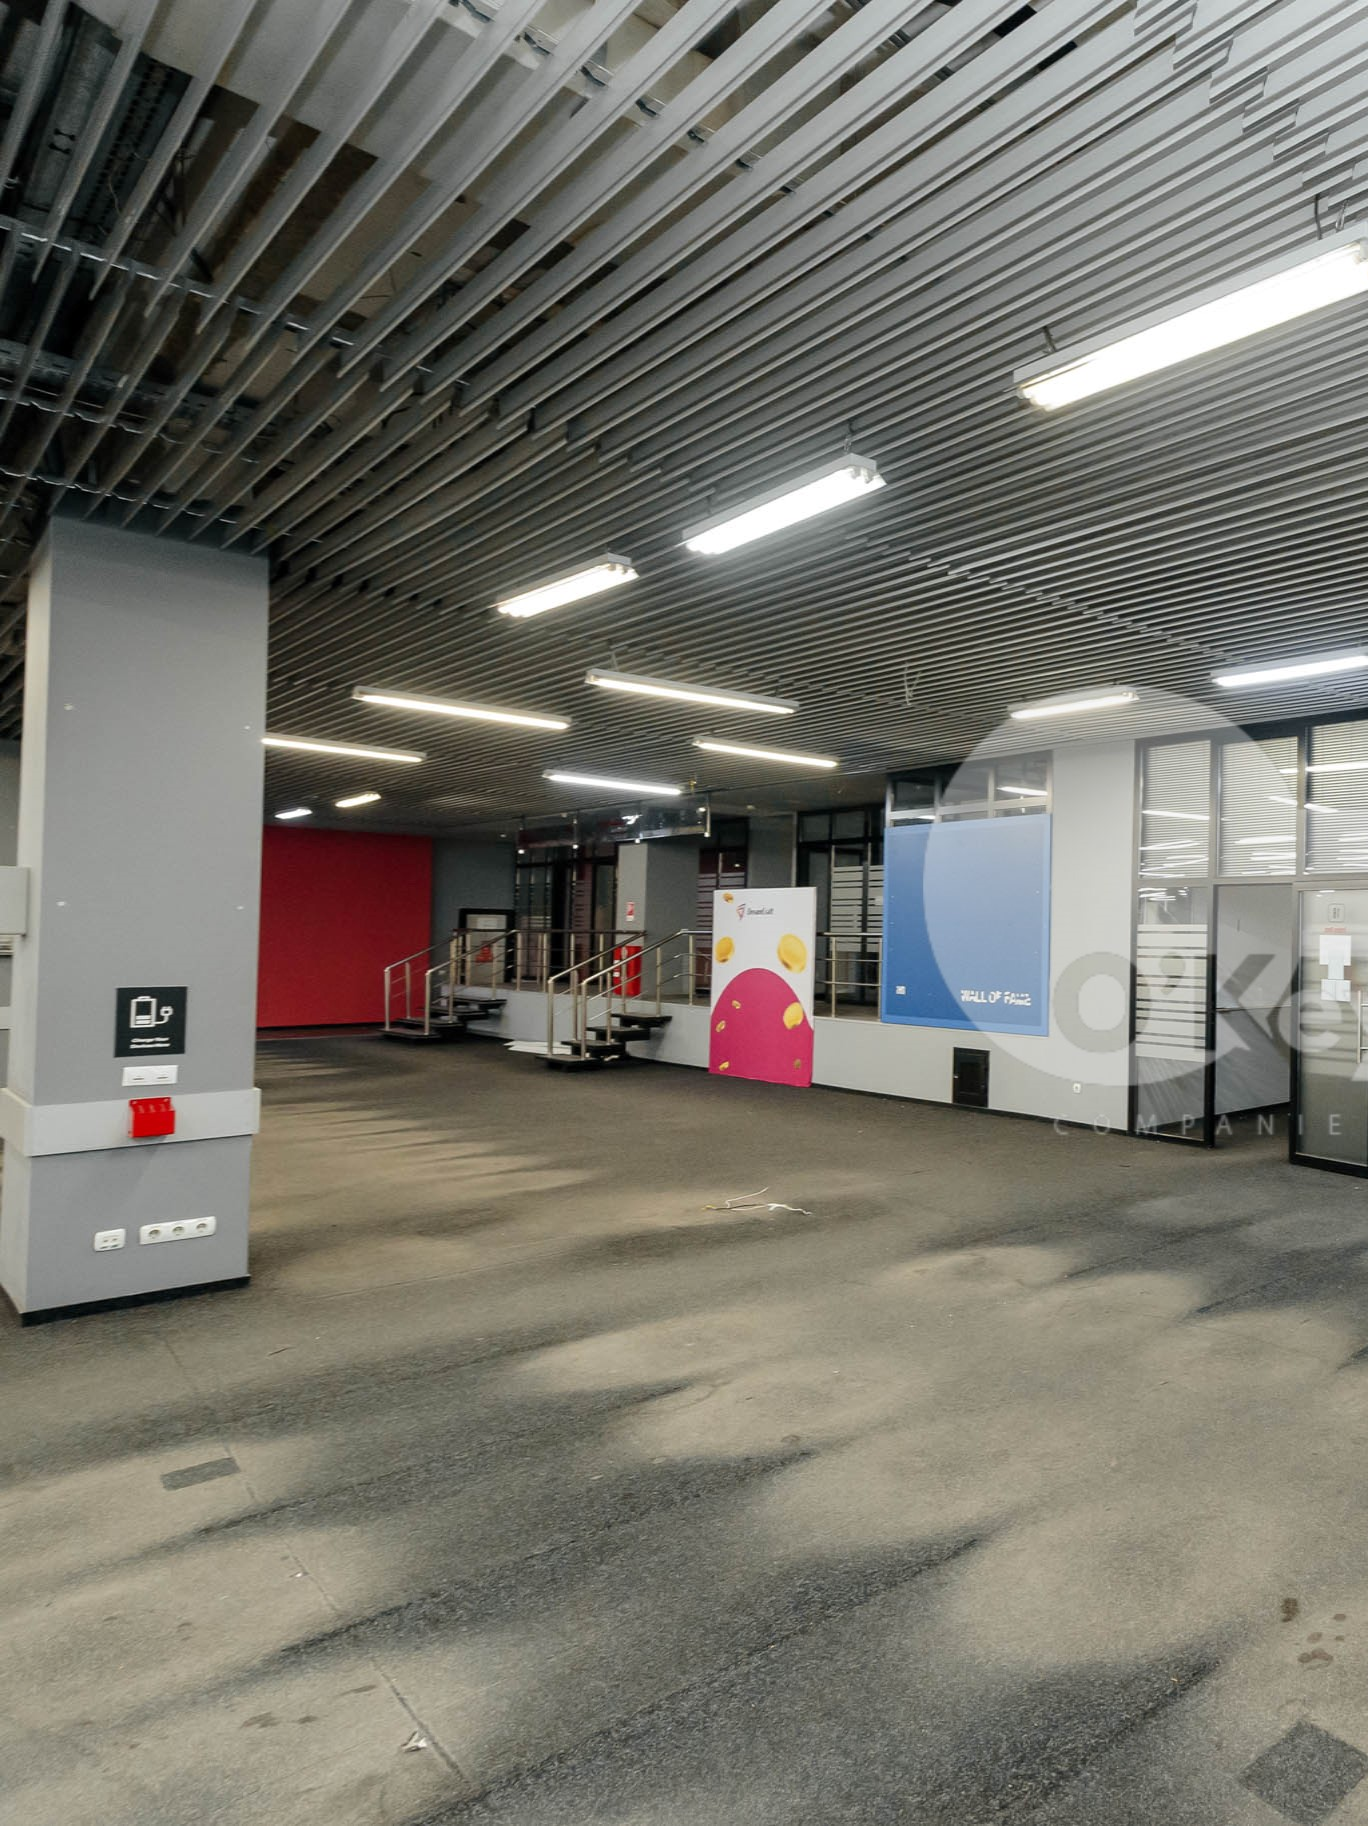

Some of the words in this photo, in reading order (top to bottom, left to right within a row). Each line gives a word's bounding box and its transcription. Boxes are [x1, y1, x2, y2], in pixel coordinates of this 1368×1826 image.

[960, 989, 988, 1003] WALL
[988, 990, 1003, 1004] OF
[1003, 991, 1032, 1007] FAME
